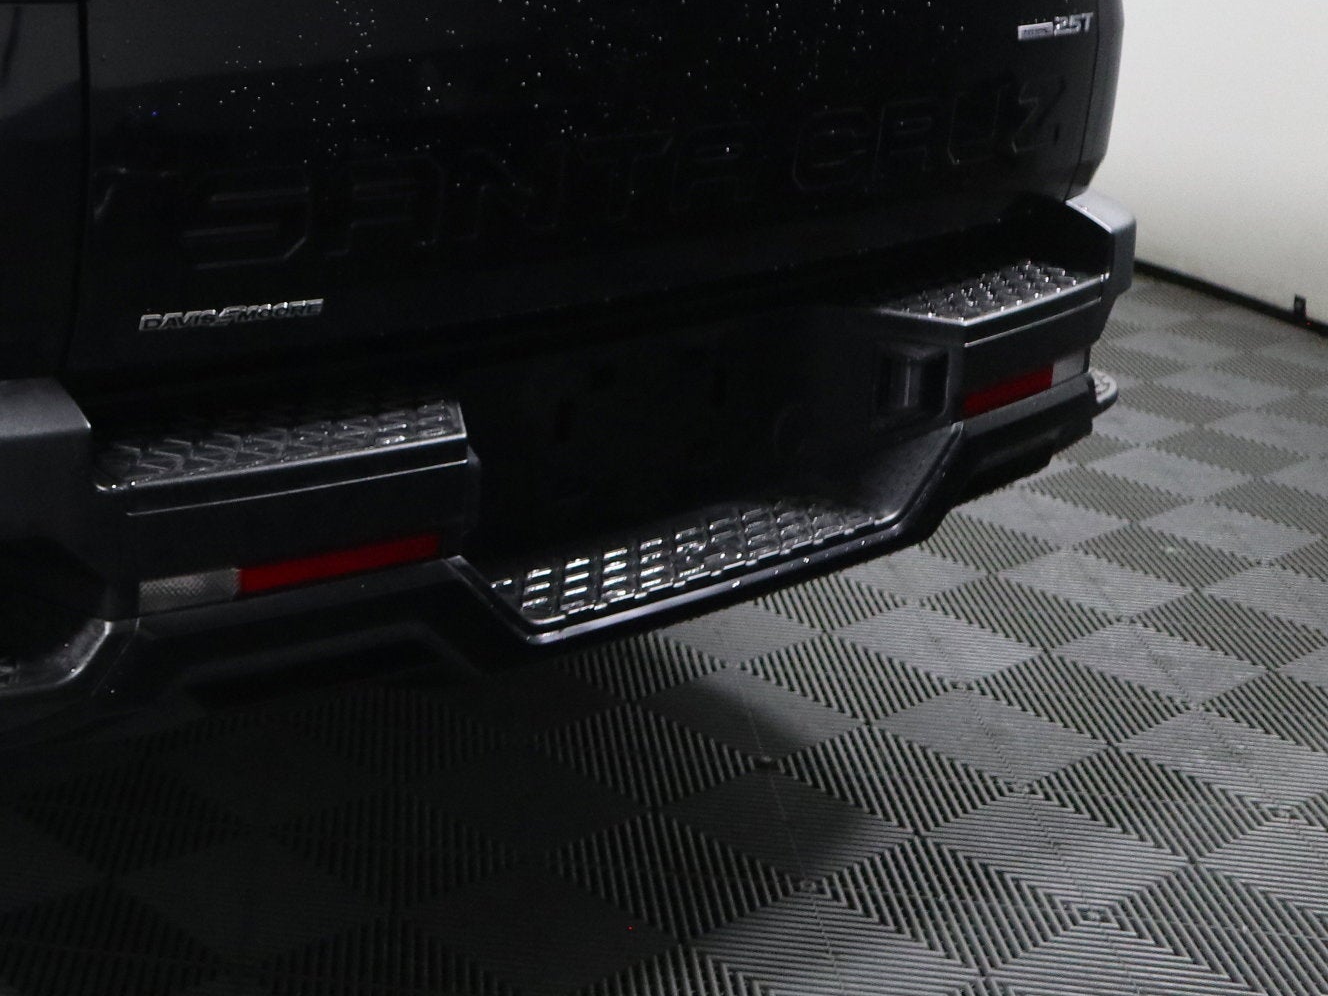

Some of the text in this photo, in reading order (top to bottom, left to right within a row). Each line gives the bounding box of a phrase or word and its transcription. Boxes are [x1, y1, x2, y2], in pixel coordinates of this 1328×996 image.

[791, 72, 1068, 194] CRUZ
[138, 298, 324, 332] DAVIS MOORE
